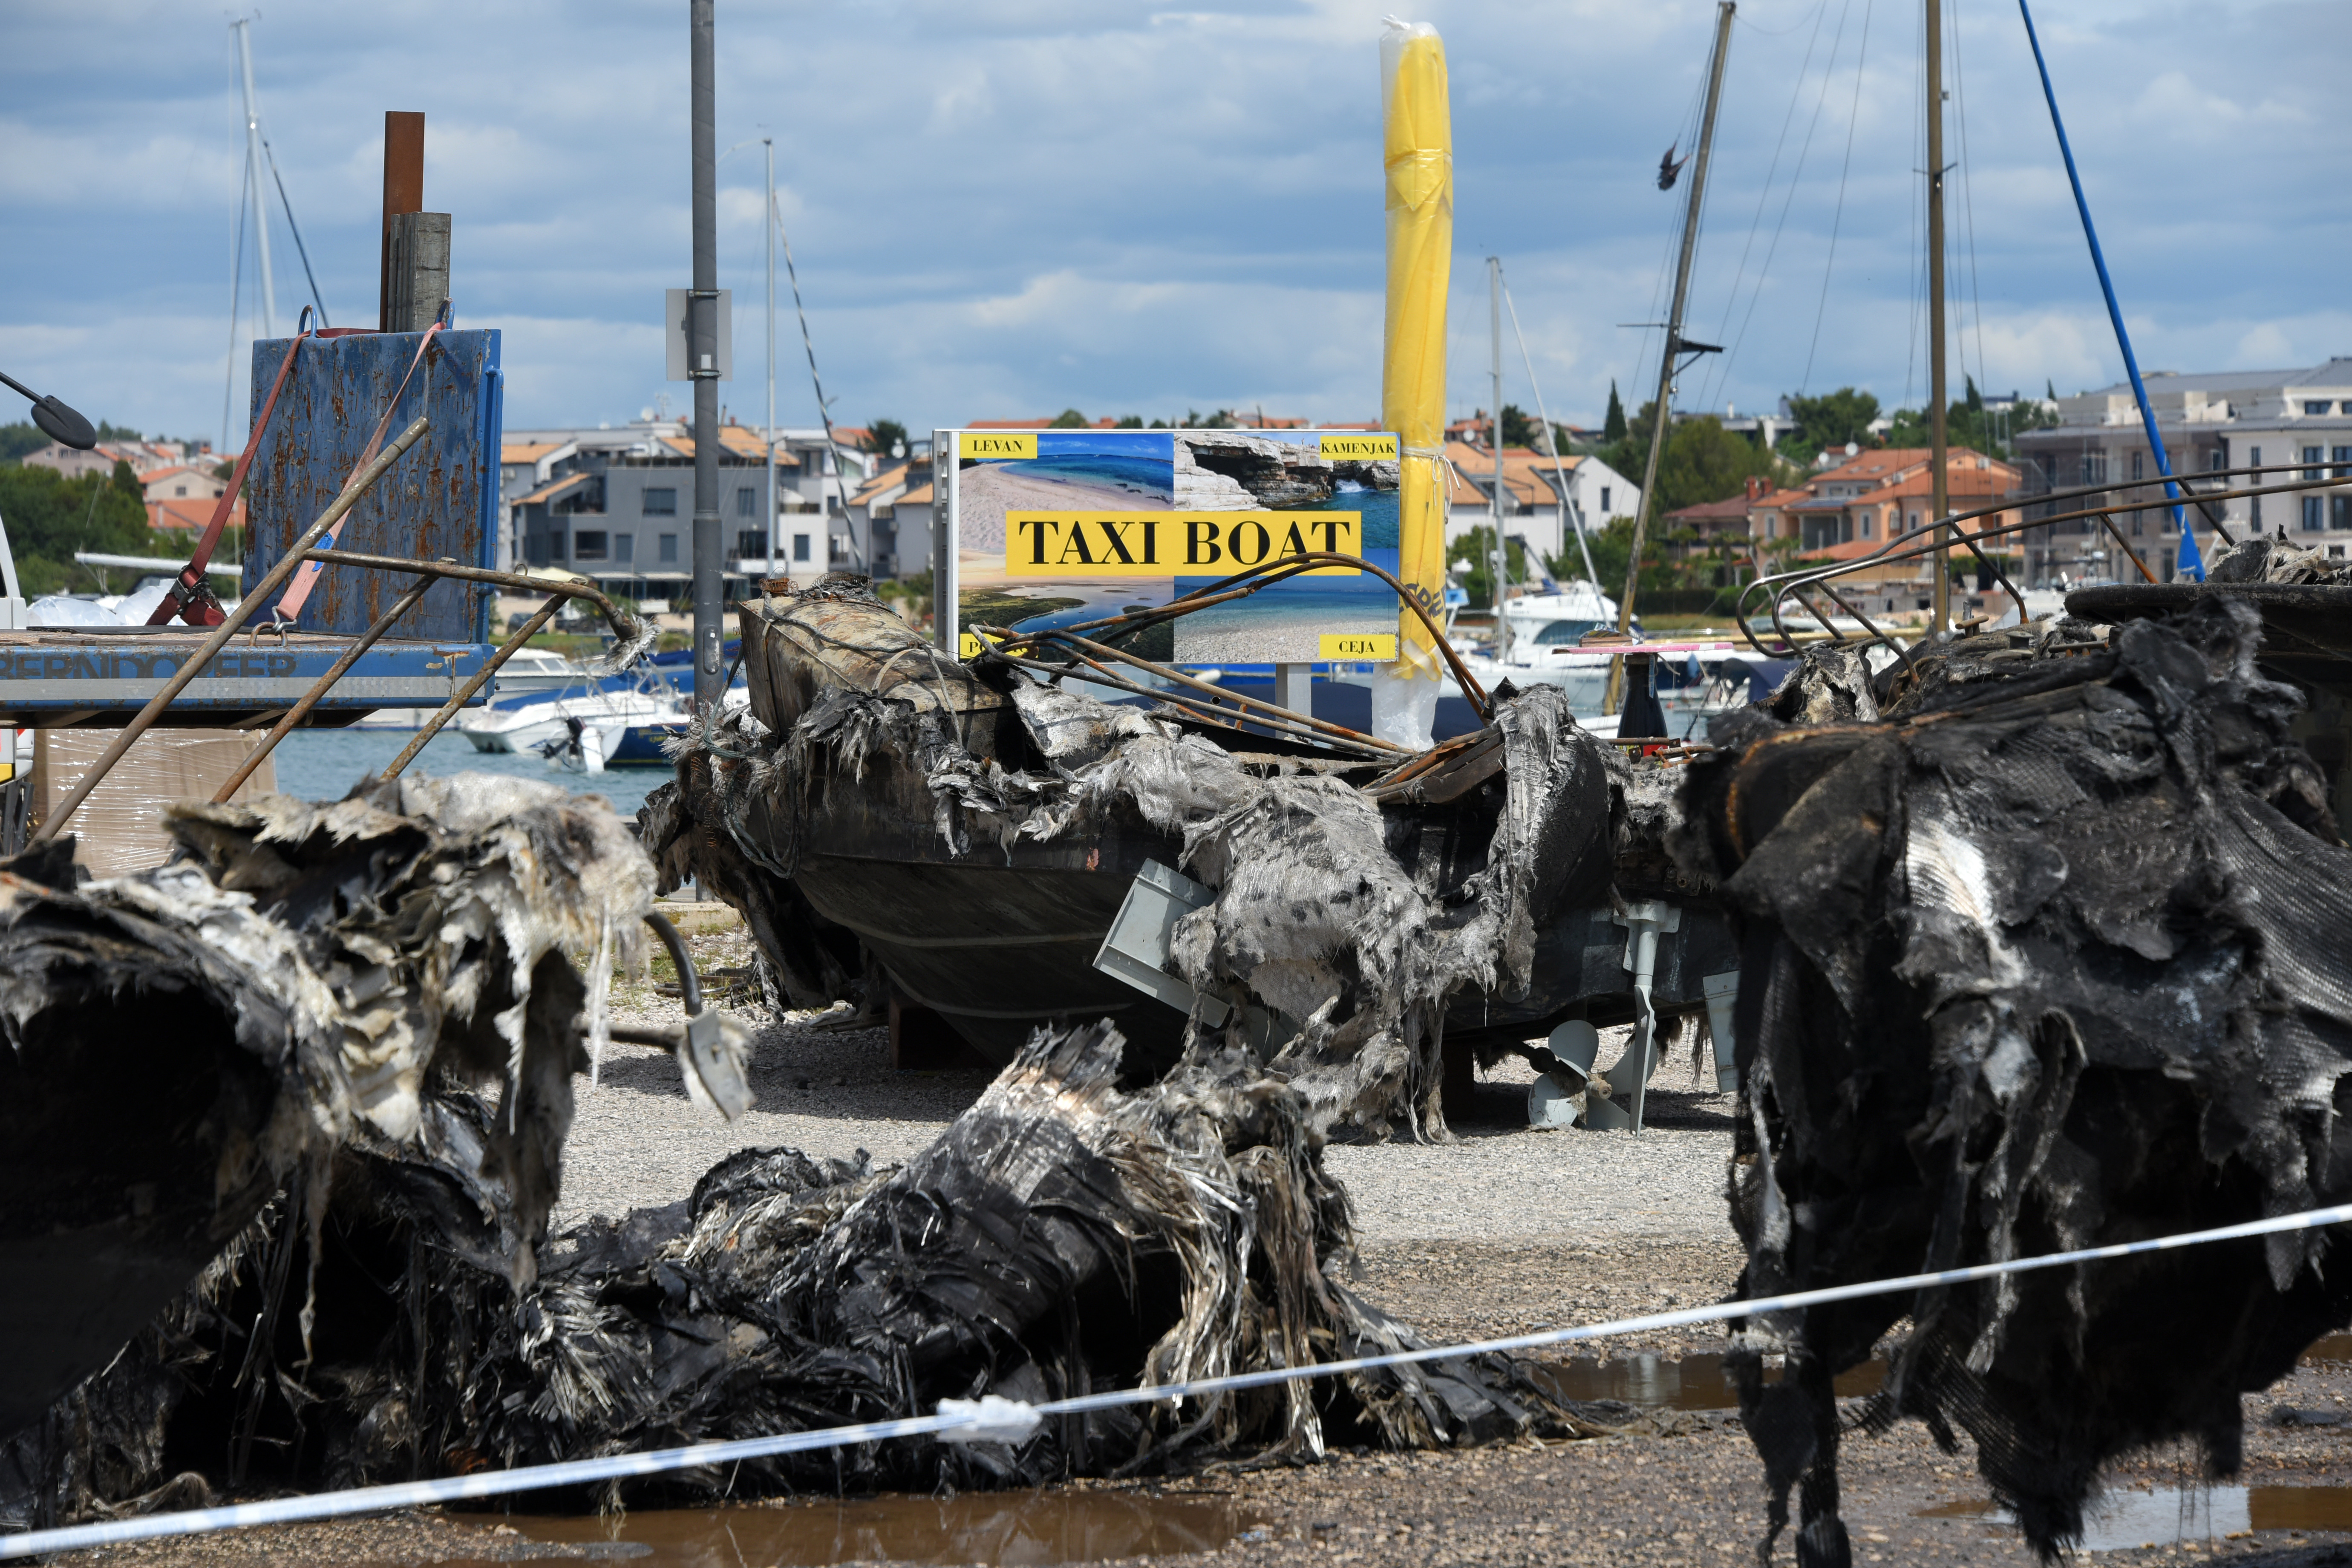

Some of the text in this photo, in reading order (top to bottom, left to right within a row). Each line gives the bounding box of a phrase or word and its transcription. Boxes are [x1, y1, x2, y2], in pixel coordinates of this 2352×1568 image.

[972, 440, 1023, 452] LEVAN
[1320, 443, 1396, 454] KAMENJAK
[1019, 521, 1350, 565] TAXI BOAT
[1338, 641, 1376, 654] CEJA
